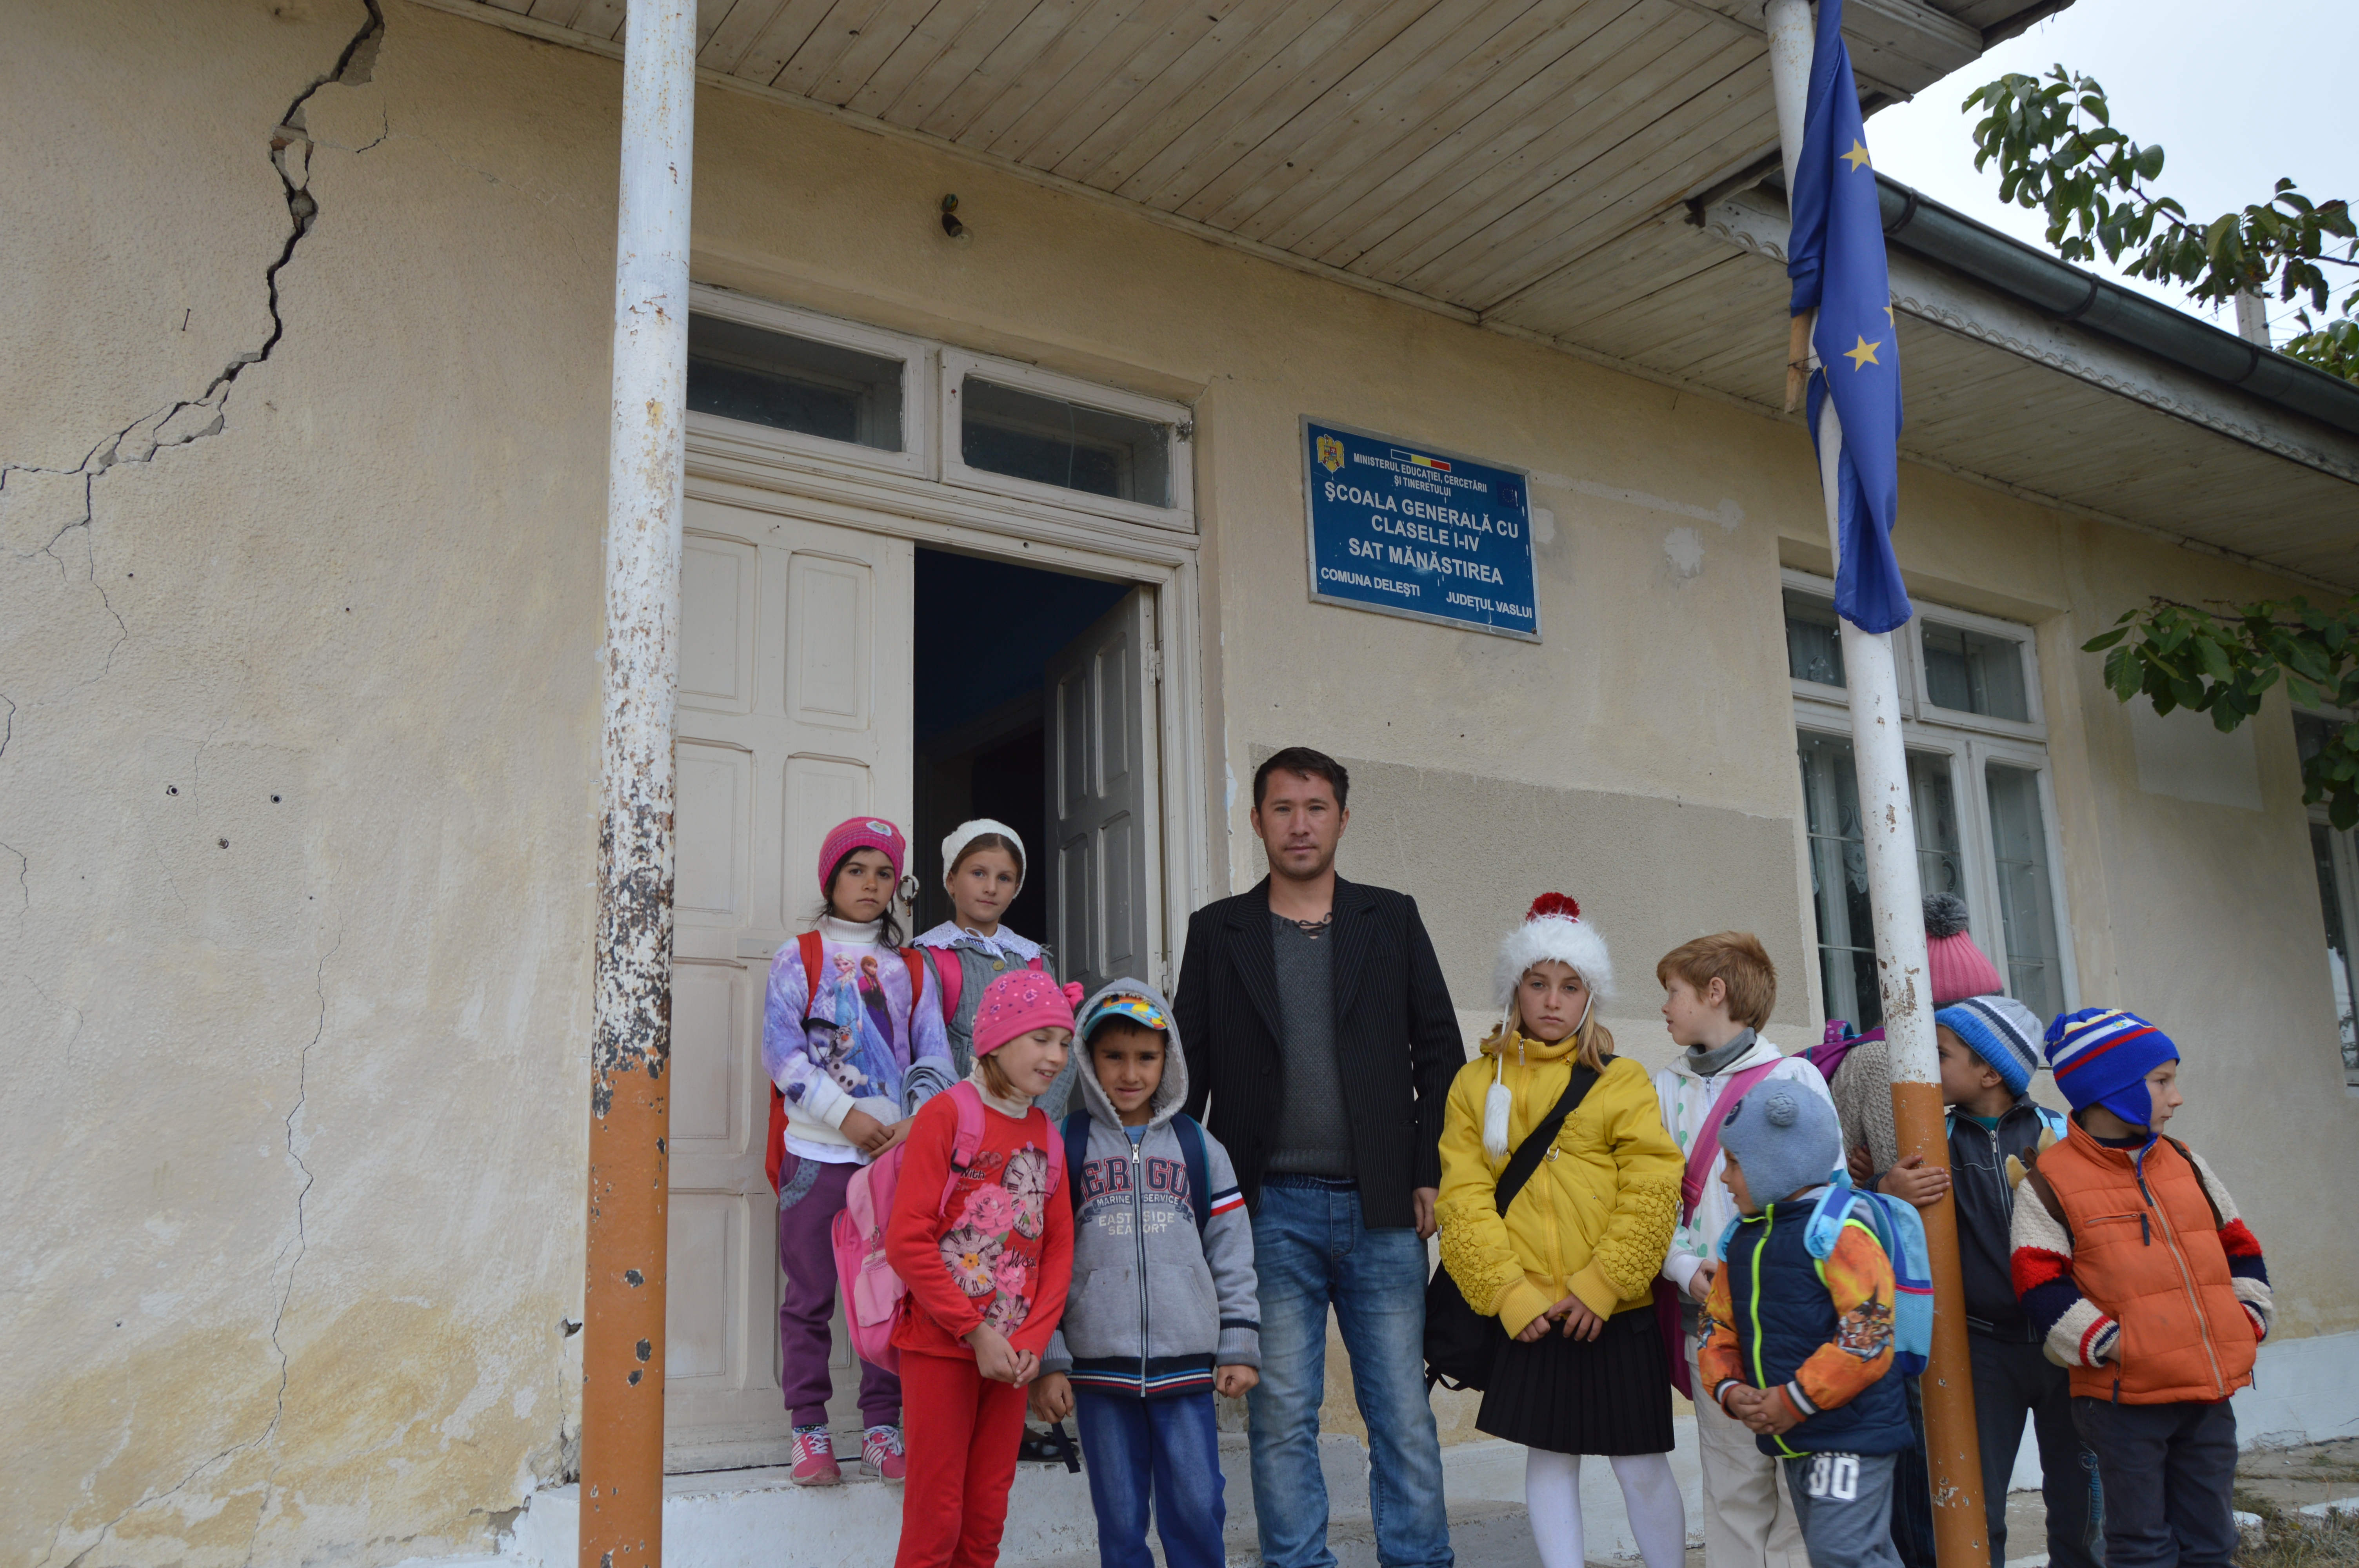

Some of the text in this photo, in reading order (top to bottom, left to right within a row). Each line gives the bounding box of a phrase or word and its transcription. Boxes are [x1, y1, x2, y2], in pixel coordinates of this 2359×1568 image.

[1354, 453, 1400, 472] MINISTERUL
[1444, 474, 1487, 493] CERCETĂRII
[1403, 477, 1451, 497] TINERETULUI
[1402, 499, 1493, 533] GENERALĂ
[1497, 520, 1518, 538] CU
[1371, 515, 1479, 552] CLASELE I-IV
[1349, 537, 1504, 585] SAT MĂNĂSTIREA
[1321, 567, 1372, 588] COMUNA
[1495, 601, 1532, 619] VASLUI
[1079, 1156, 1132, 1206] ER
[1096, 1194, 1180, 1207] MARINE SERVICE
[1098, 1210, 1175, 1227] EAST SIDE
